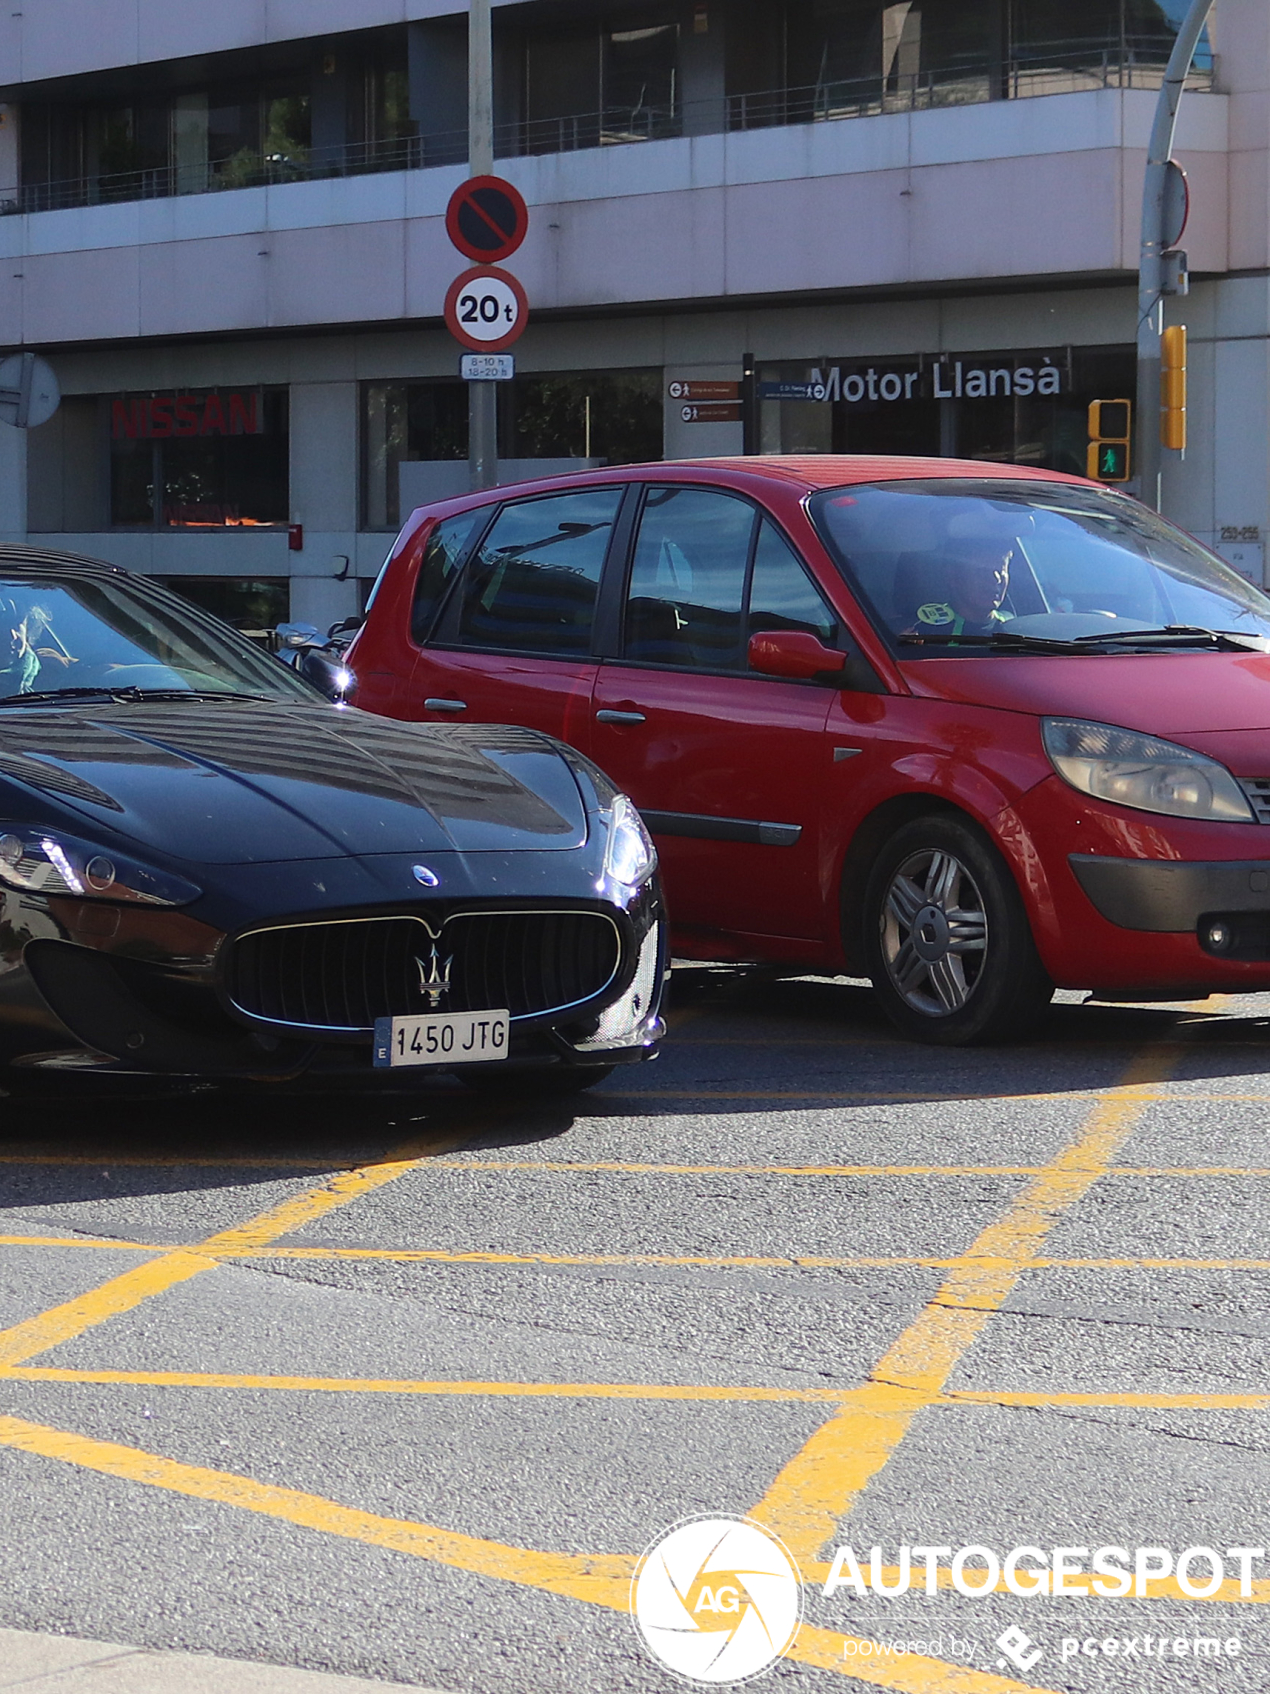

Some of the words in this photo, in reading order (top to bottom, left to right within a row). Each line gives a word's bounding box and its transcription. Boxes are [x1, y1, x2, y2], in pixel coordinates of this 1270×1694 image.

[460, 295, 499, 323] 20
[504, 304, 513, 322] t
[471, 357, 495, 367] 8-10
[810, 367, 918, 403] Motor
[933, 357, 1060, 399] Llansà
[112, 393, 257, 439] NISSAN
[378, 1048, 387, 1059] E
[397, 1025, 454, 1056] 1450
[462, 1020, 505, 1051] JTG
